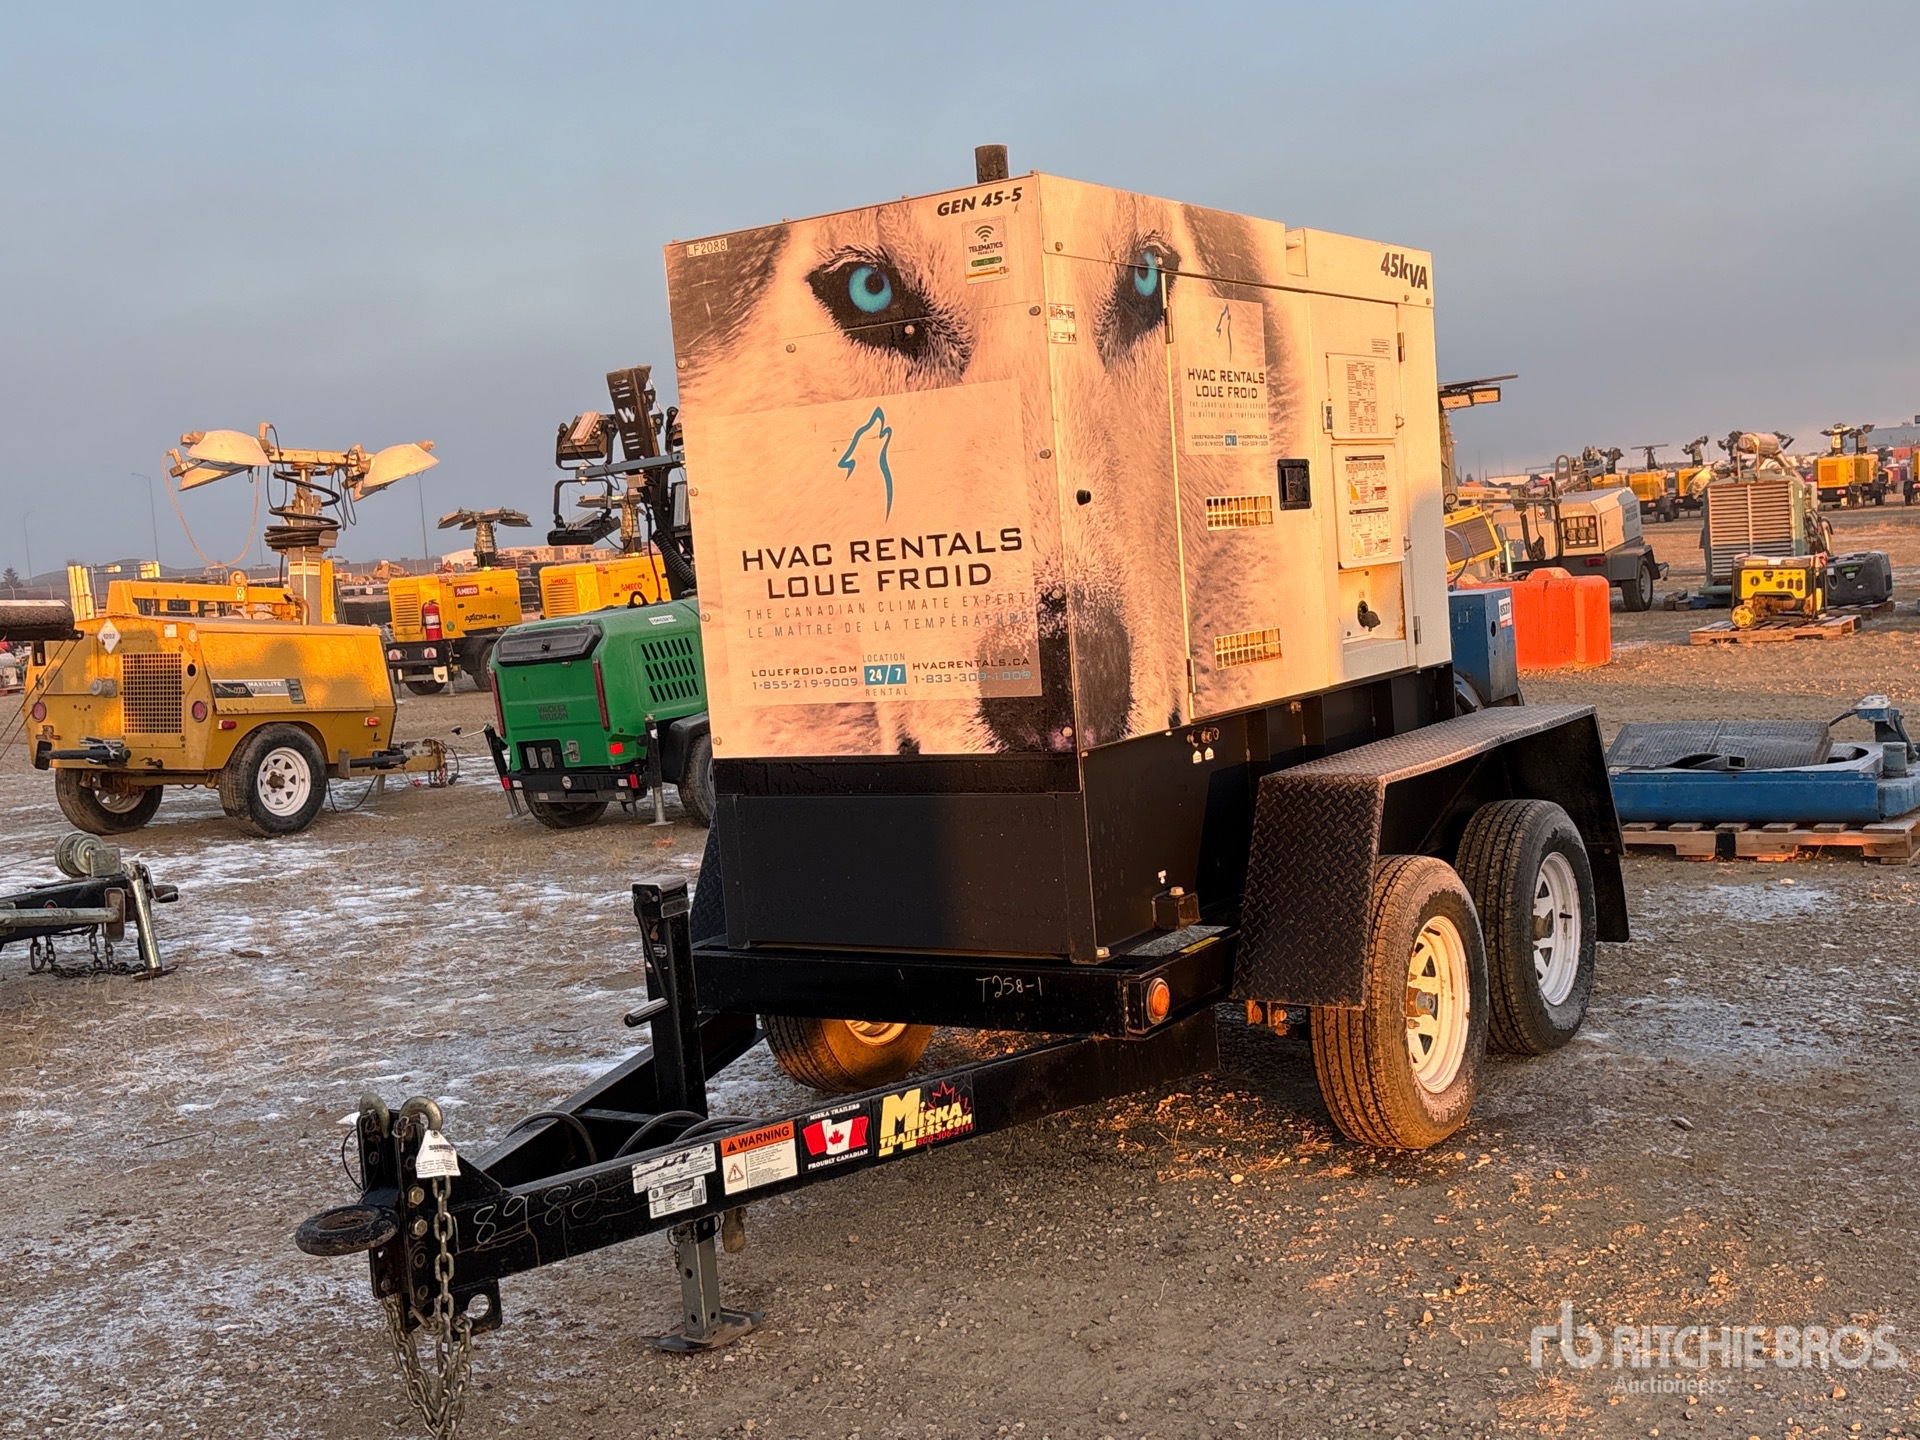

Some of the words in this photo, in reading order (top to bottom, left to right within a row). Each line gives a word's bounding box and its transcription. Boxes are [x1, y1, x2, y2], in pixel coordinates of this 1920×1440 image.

[937, 196, 977, 217] GEN
[981, 187, 1023, 207] 45-5
[687, 239, 726, 257] LF2088
[968, 241, 1004, 253] TELEMATICS
[1380, 252, 1428, 290] 45kVA
[1187, 368, 1216, 381] HVAC
[1220, 370, 1265, 384] RENTALS
[1195, 385, 1224, 398] LOUE
[1227, 386, 1258, 399] FROID
[742, 543, 833, 571] HVAC
[849, 527, 1023, 563] RENTALS
[456, 586, 478, 595] AMECO
[767, 572, 860, 600] LOUE
[877, 563, 992, 592] FROID
[746, 608, 772, 620] THE
[784, 603, 865, 618] CANADIAN
[878, 597, 949, 613] CLIMATE
[962, 592, 1026, 607] EXPERT
[748, 627, 763, 639] LE
[845, 621, 862, 634] DE
[874, 620, 891, 632] LA
[751, 666, 857, 678] LOUEFROID.COM
[912, 658, 1030, 670] HVACRENTALS.CA
[862, 653, 906, 663] LOCATION
[752, 678, 858, 690] 1-855-219-9009
[914, 670, 1031, 684] 1-833-309-1009
[865, 687, 909, 697] RENTAL
[738, 1126, 790, 1149] WARNING
[880, 1113, 973, 1149] TRAILERS.COM
[808, 1157, 835, 1170] PROUDLY
[836, 1149, 869, 1162] CANADIAN
